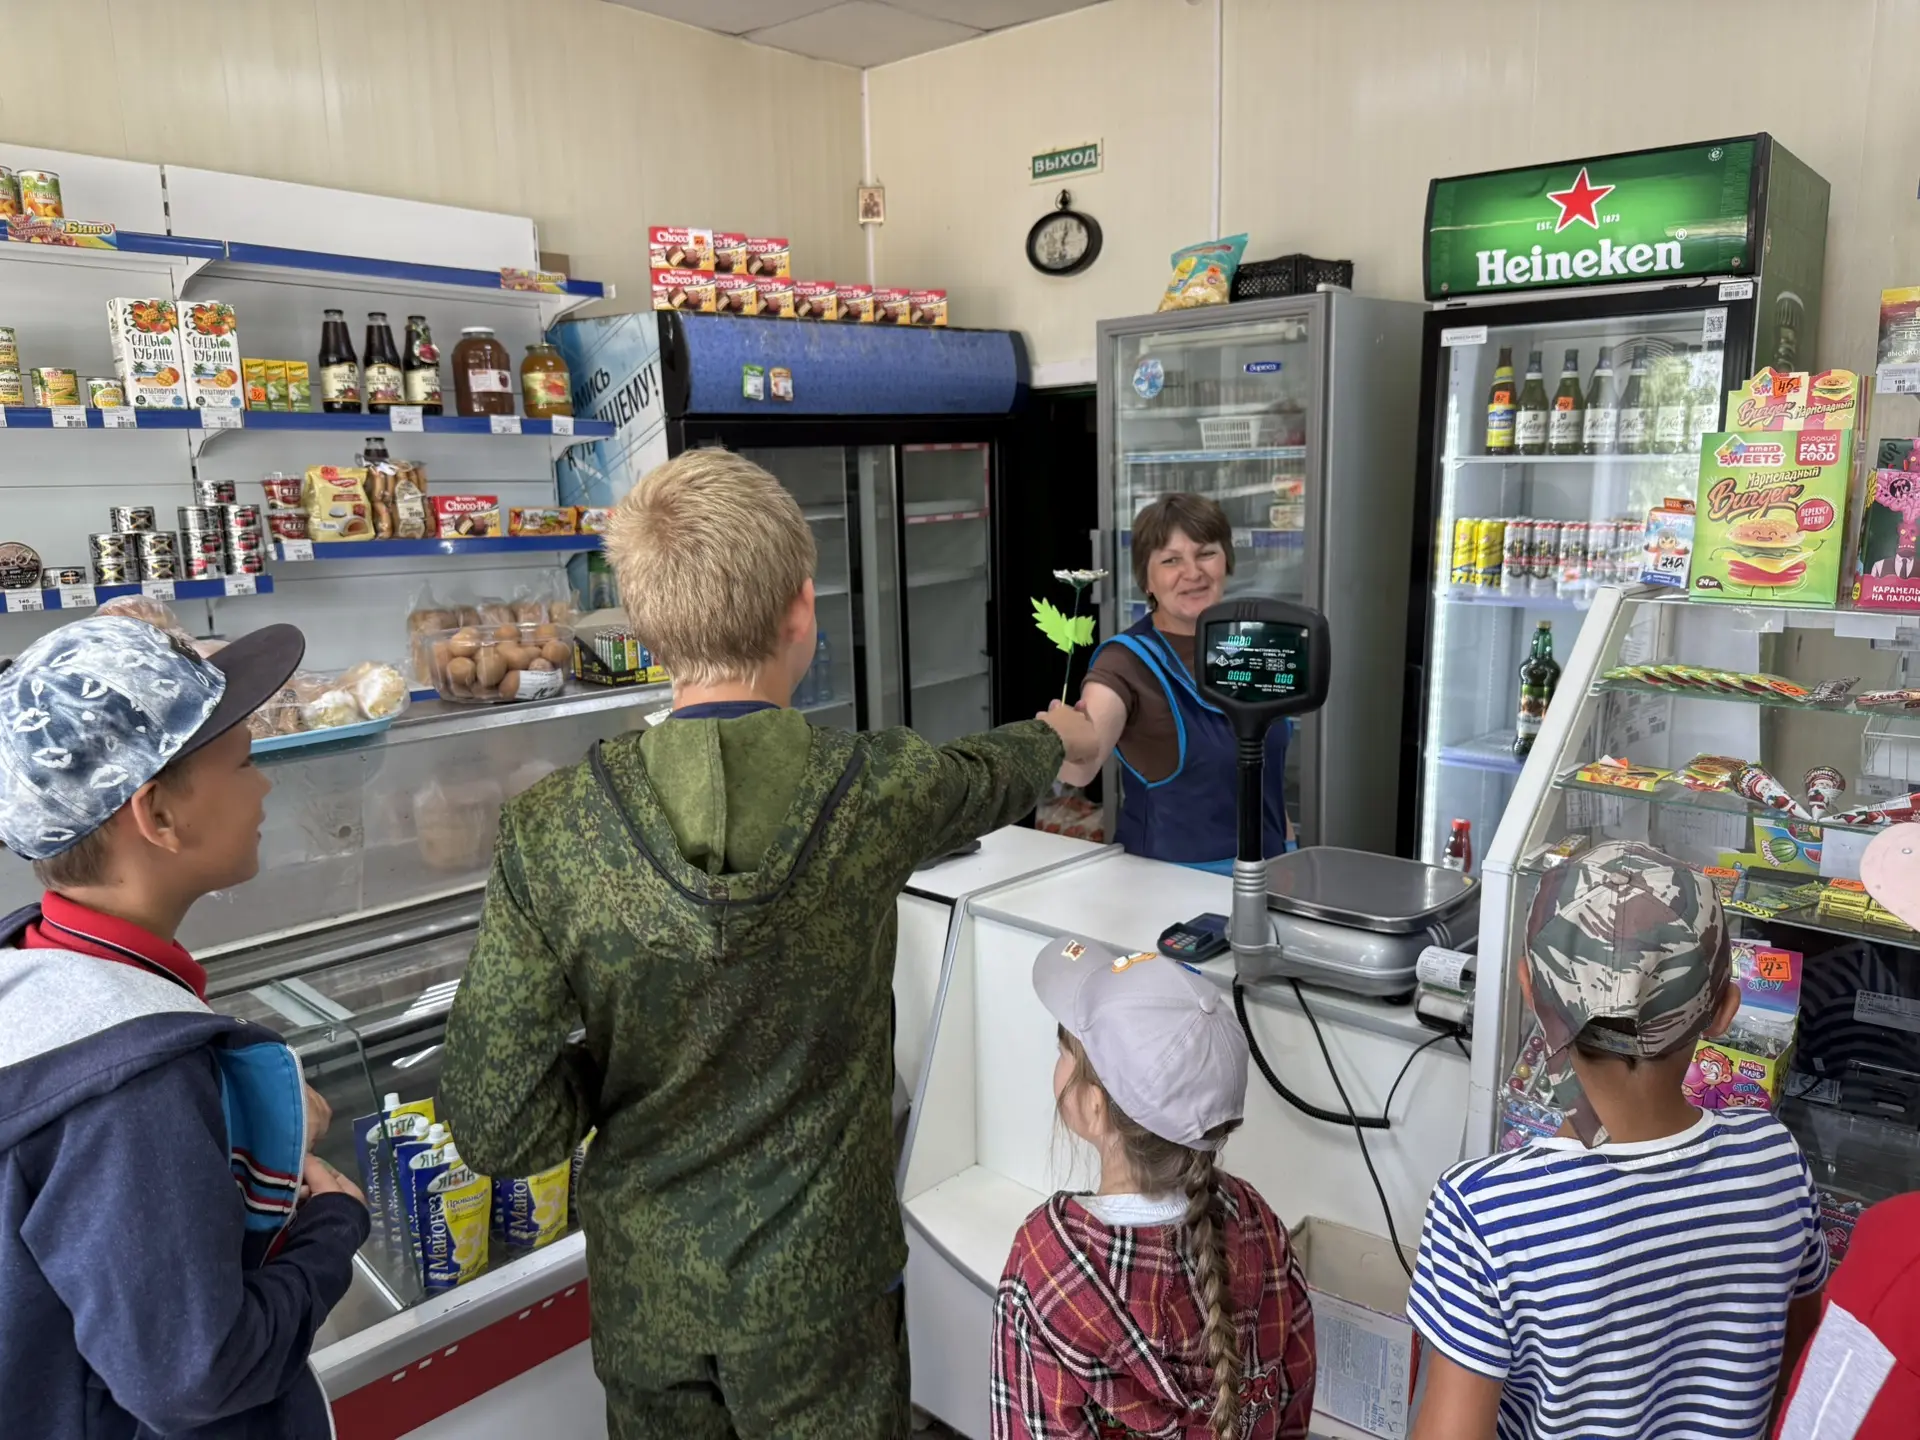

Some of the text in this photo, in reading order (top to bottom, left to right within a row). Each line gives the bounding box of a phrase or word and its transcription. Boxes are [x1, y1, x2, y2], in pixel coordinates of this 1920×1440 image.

[1034, 148, 1097, 174] ВЫХОД
[63, 220, 112, 235] Бинго
[1536, 213, 1620, 231] EST. 1873
[1475, 238, 1684, 287] Heineken
[131, 333, 160, 347] САДЫ
[192, 336, 220, 349] САДЫ
[133, 347, 175, 361] КУБАНИ
[194, 349, 233, 363] КУБАНИ
[1737, 399, 1796, 427] Burger
[1793, 400, 1855, 419] Мармеладный
[1800, 443, 1836, 452] FAST
[1719, 453, 1784, 465] SWEETS
[1799, 452, 1835, 461] FOOD
[1746, 467, 1821, 489] Мармеладный
[444, 499, 492, 512] Choco-Pie
[1707, 478, 1804, 522] Burger
[1872, 593, 1883, 601] НА
[1873, 585, 1920, 595] КАРАМЕЛЬ
[428, 1193, 449, 1271] Майонез
